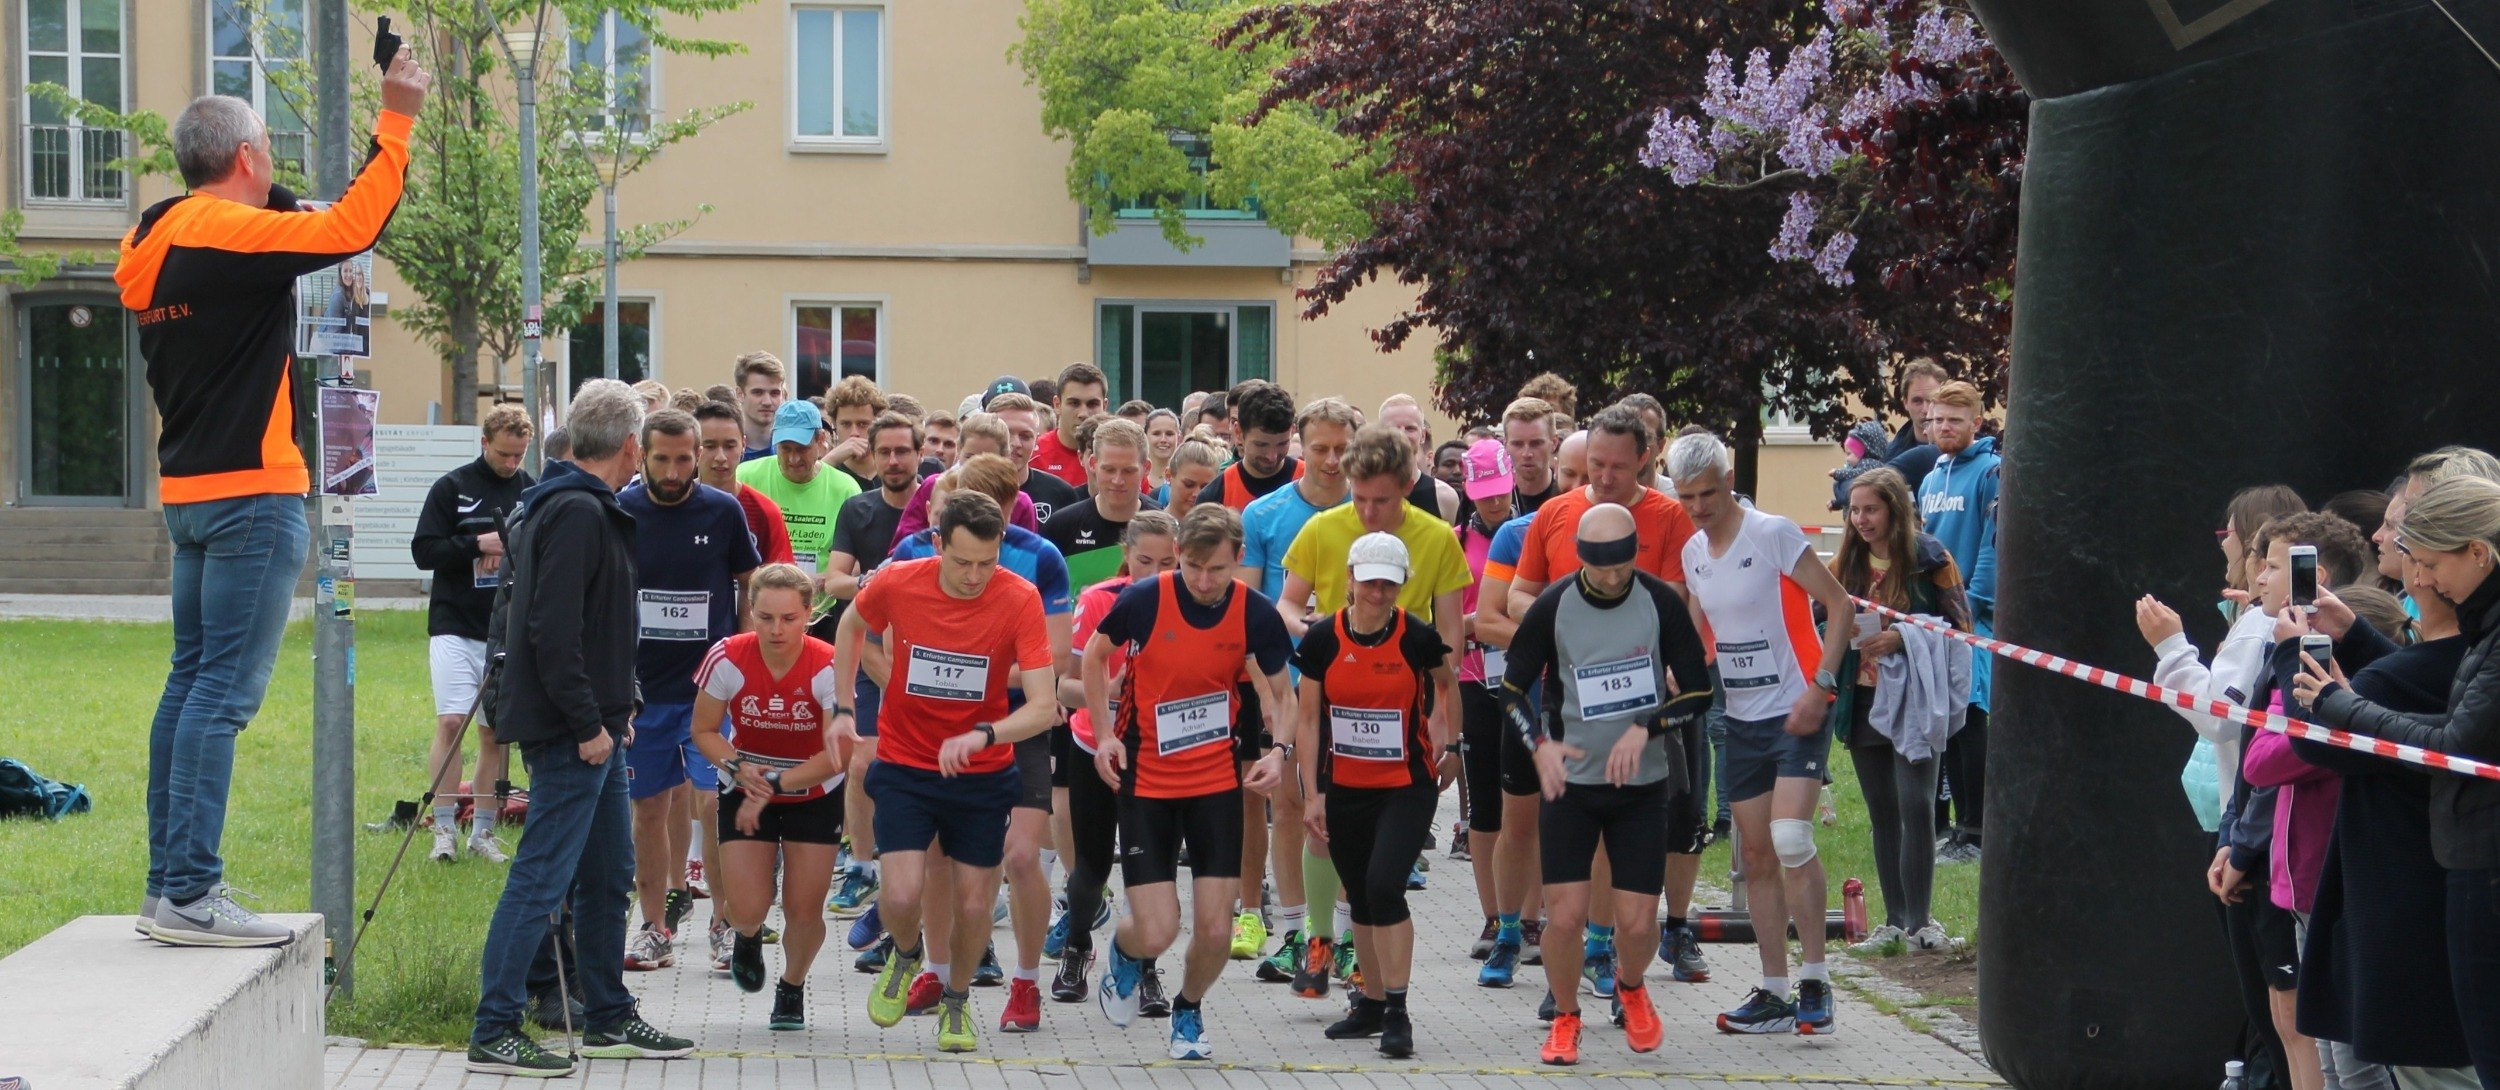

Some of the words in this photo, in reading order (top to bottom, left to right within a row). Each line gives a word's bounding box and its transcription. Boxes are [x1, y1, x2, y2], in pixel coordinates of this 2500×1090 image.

[661, 606, 689, 618] 162
[922, 652, 946, 661] Erfurter
[947, 656, 984, 666] Campuslauf
[1731, 655, 1754, 668] 187
[933, 665, 965, 679] 117
[1588, 666, 1612, 676] Erfurter
[1612, 659, 1649, 671] Campuslauf
[935, 680, 958, 688] Tobias
[1601, 676, 1633, 692] 183
[1167, 702, 1190, 712] Erfurter
[1191, 694, 1225, 706] Campuslauf
[1178, 707, 1208, 723] 142
[1341, 710, 1362, 718] Erfurter
[1363, 712, 1398, 720] Campuslauf
[740, 716, 752, 727] SC
[753, 719, 817, 732] Ostheim/Rhön
[1182, 723, 1206, 734] Adrian
[1351, 722, 1381, 734] 130
